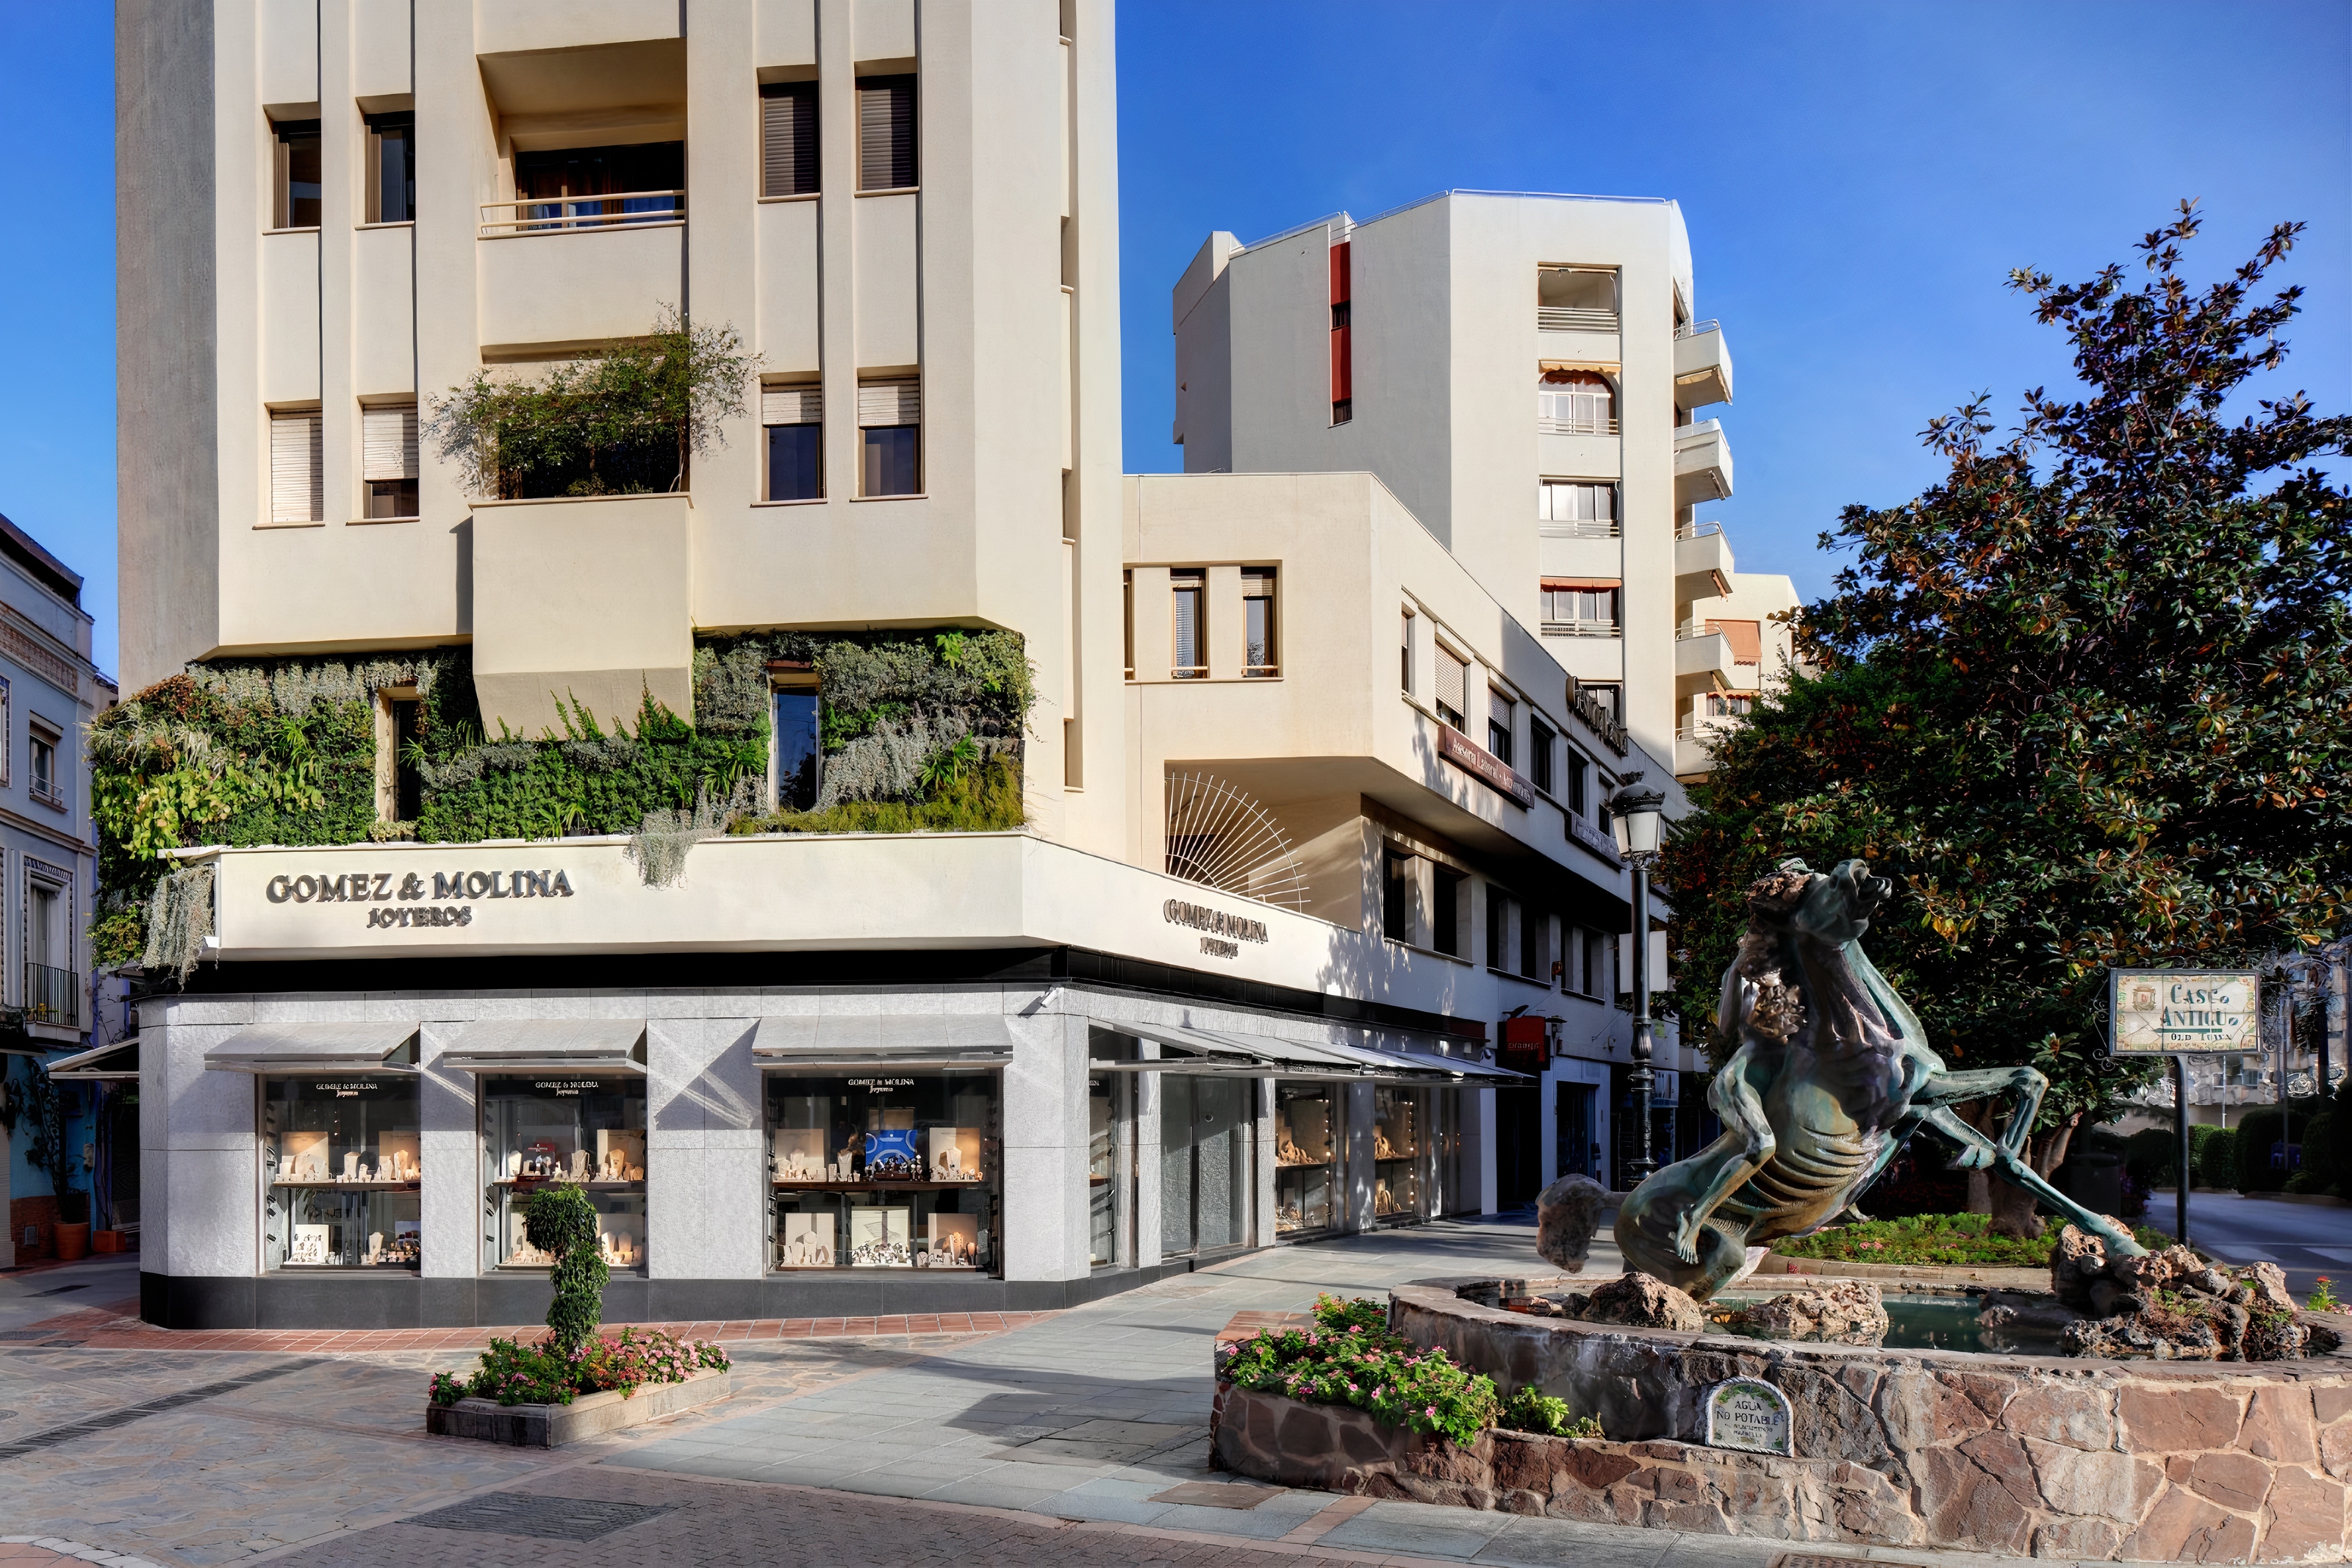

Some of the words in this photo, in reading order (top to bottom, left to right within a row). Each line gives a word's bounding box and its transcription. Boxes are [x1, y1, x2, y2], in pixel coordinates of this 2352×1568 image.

[266, 874, 393, 903] GOMEZ
[397, 871, 426, 901] &
[431, 868, 575, 900] MOLINA
[367, 905, 473, 929] JOYEROS
[1735, 1400, 1763, 1411] AGUA
[1716, 1411, 1730, 1420] NO
[1735, 1412, 1779, 1425] POTABLE
